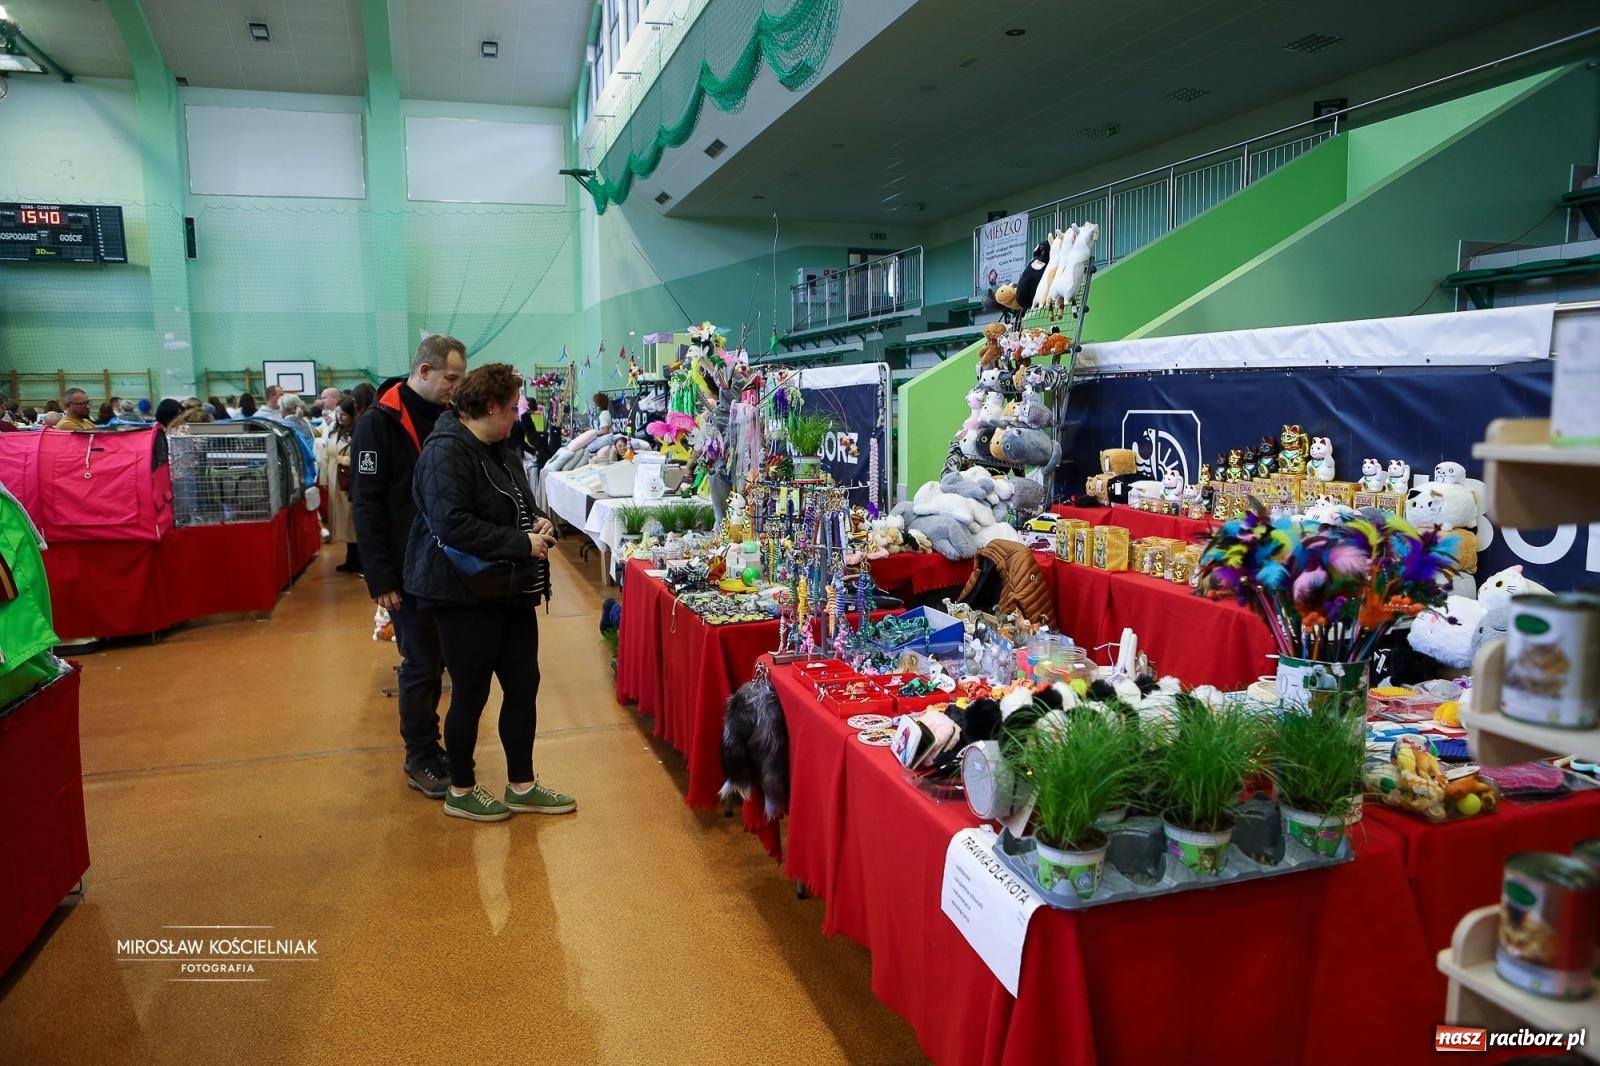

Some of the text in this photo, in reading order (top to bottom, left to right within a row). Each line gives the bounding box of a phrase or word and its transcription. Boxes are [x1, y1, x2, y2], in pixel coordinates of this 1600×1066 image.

[0, 233, 38, 241] OSPODARZE
[984, 219, 1022, 241] MIESZKO
[961, 836, 993, 869] TRAWKA
[988, 863, 1009, 884] DLA
[1003, 879, 1031, 905] KOTA
